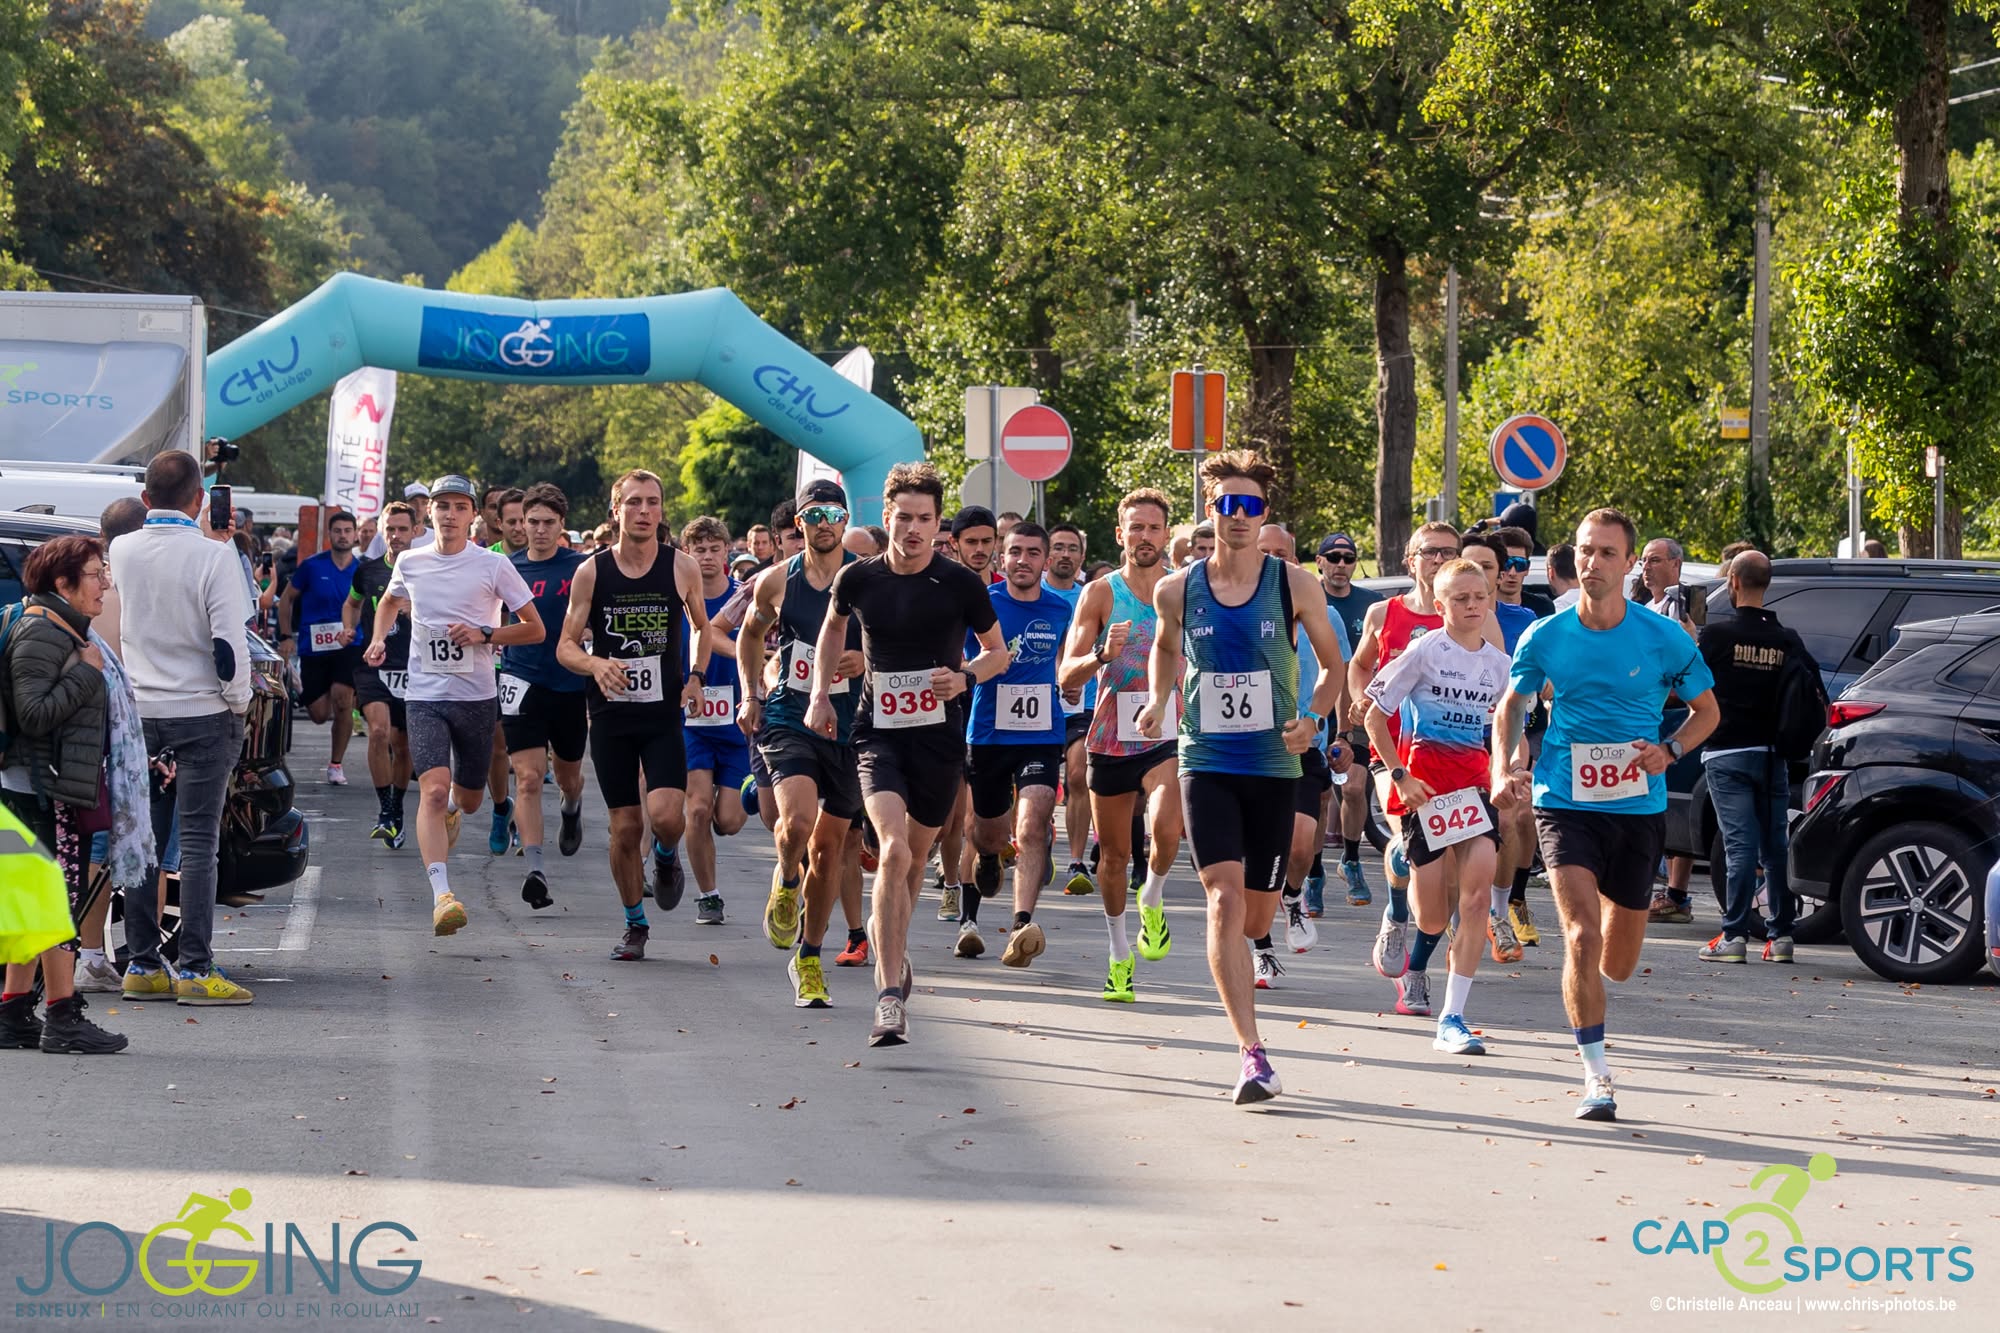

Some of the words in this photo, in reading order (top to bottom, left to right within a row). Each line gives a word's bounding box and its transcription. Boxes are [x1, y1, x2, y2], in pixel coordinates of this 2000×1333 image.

[443, 328, 629, 367] JOGGING
[220, 336, 299, 406] CHU
[8, 390, 113, 410] SPORTS
[256, 390, 273, 403] de
[753, 365, 850, 418] CHU
[767, 397, 786, 411] de
[613, 606, 648, 614] DESCENTE
[614, 613, 668, 632] LESSE
[1026, 632, 1056, 640] RUNNING
[1033, 641, 1051, 650] TEAM
[429, 640, 464, 661] 133
[622, 668, 652, 691] 58
[880, 688, 938, 716] 938
[1010, 696, 1039, 719] 40
[1221, 692, 1253, 719] 36
[1579, 763, 1640, 789] 984
[1428, 805, 1484, 837] 942
